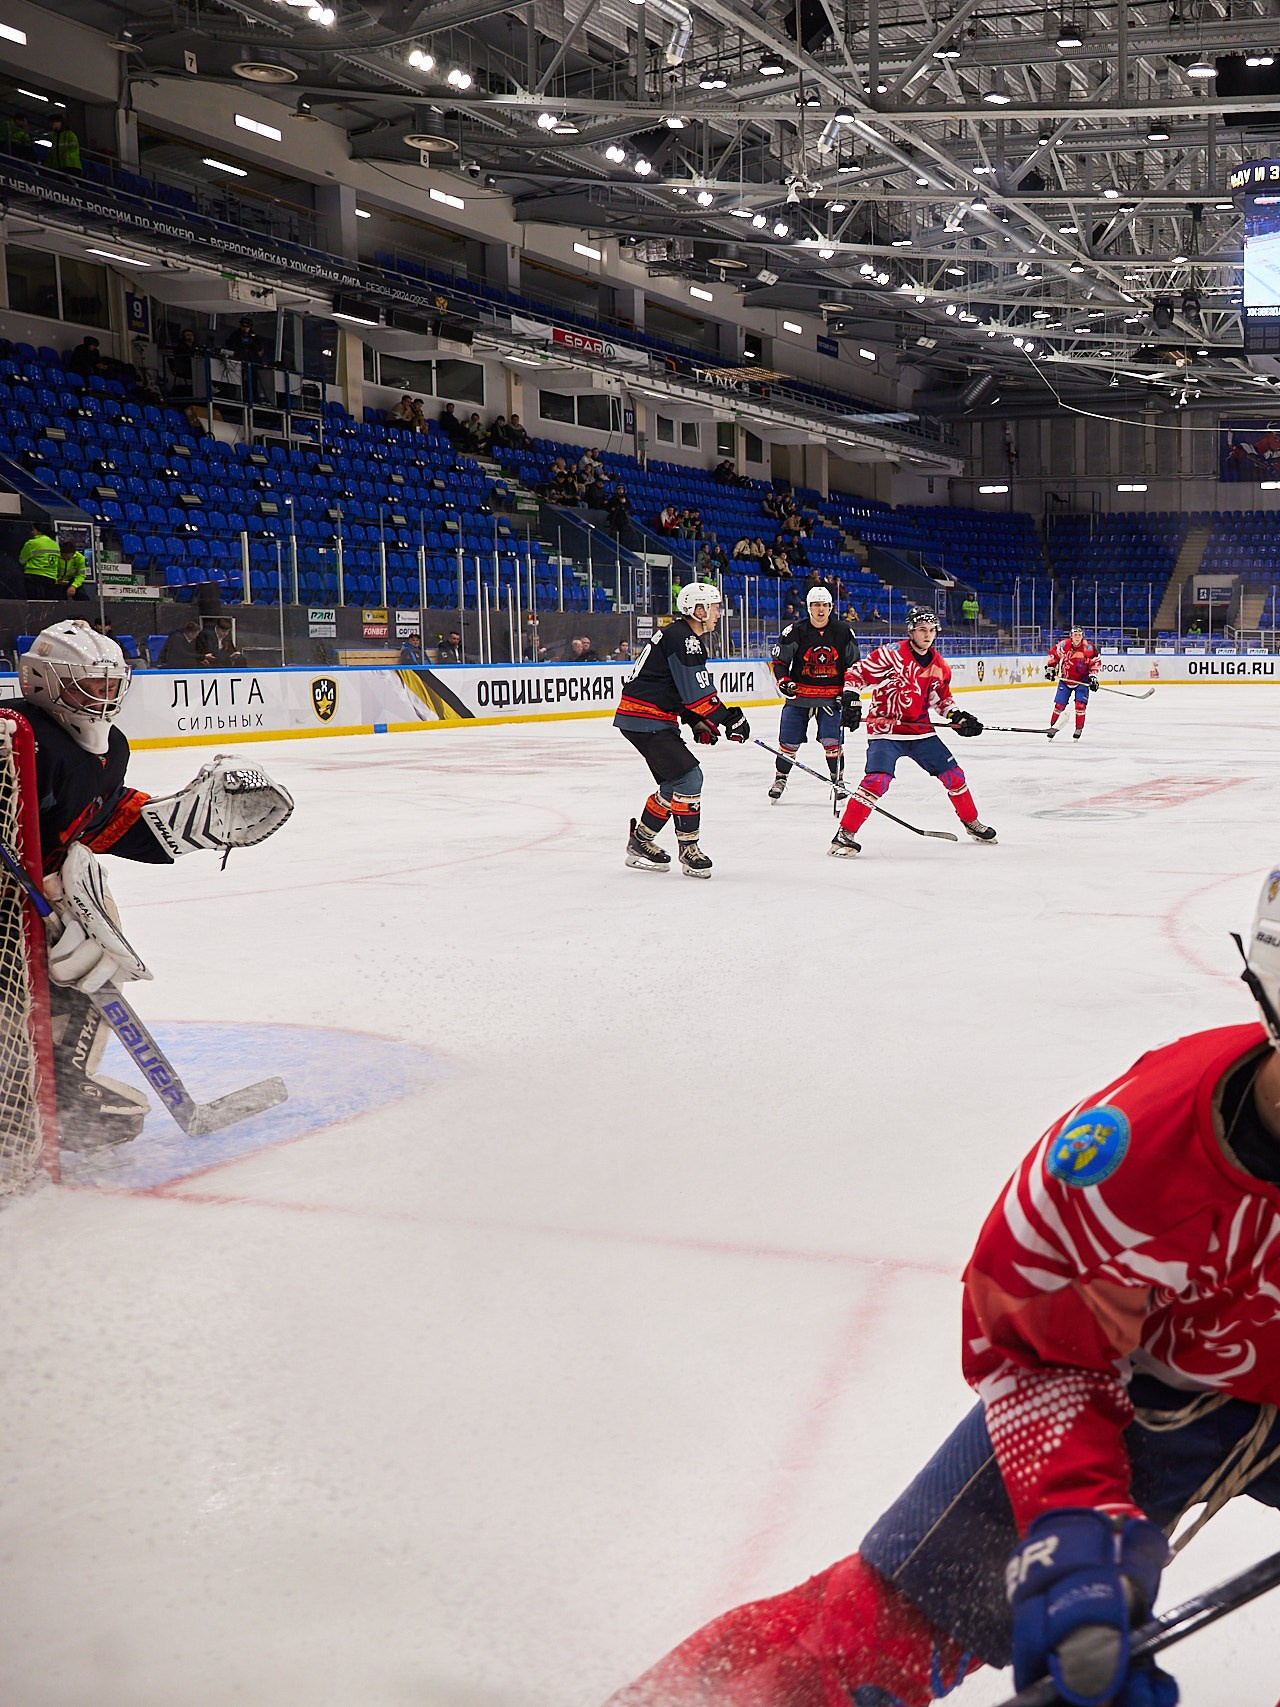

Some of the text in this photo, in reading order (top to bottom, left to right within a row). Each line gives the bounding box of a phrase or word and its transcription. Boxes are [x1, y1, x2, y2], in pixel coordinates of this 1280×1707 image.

[187, 57, 195, 68] 7
[1254, 167, 1265, 181] И
[8, 178, 83, 208] ЧЕМПИОНАТ
[86, 201, 132, 223] РОССИИ
[134, 216, 151, 228] ПО
[152, 221, 195, 240] ХОККЕЮ
[209, 236, 289, 267] ВСЕРОССИЙСКАЯ
[288, 258, 340, 282] ХОККЕЙНАЯ
[340, 274, 362, 288] ЛИГА
[365, 281, 392, 296] СЕЗОН
[133, 300, 143, 319] 9
[564, 334, 603, 354] SPAR
[690, 367, 738, 393] TANK
[625, 411, 634, 425] 10
[310, 611, 334, 620] PARI
[363, 627, 387, 636] FONBET
[1188, 661, 1275, 675] OHLIGA.RU
[695, 671, 710, 689] 99
[170, 677, 266, 709] ЛИГА
[315, 679, 335, 701] ОХЛ
[477, 671, 755, 709] ОФИЦЕРСКАЯ ЛИГА
[177, 713, 264, 731] СИЛЬНЫХ
[146, 811, 184, 857] MIKLIN
[1, 843, 21, 867] MACH
[102, 1000, 185, 1107] BAUER
